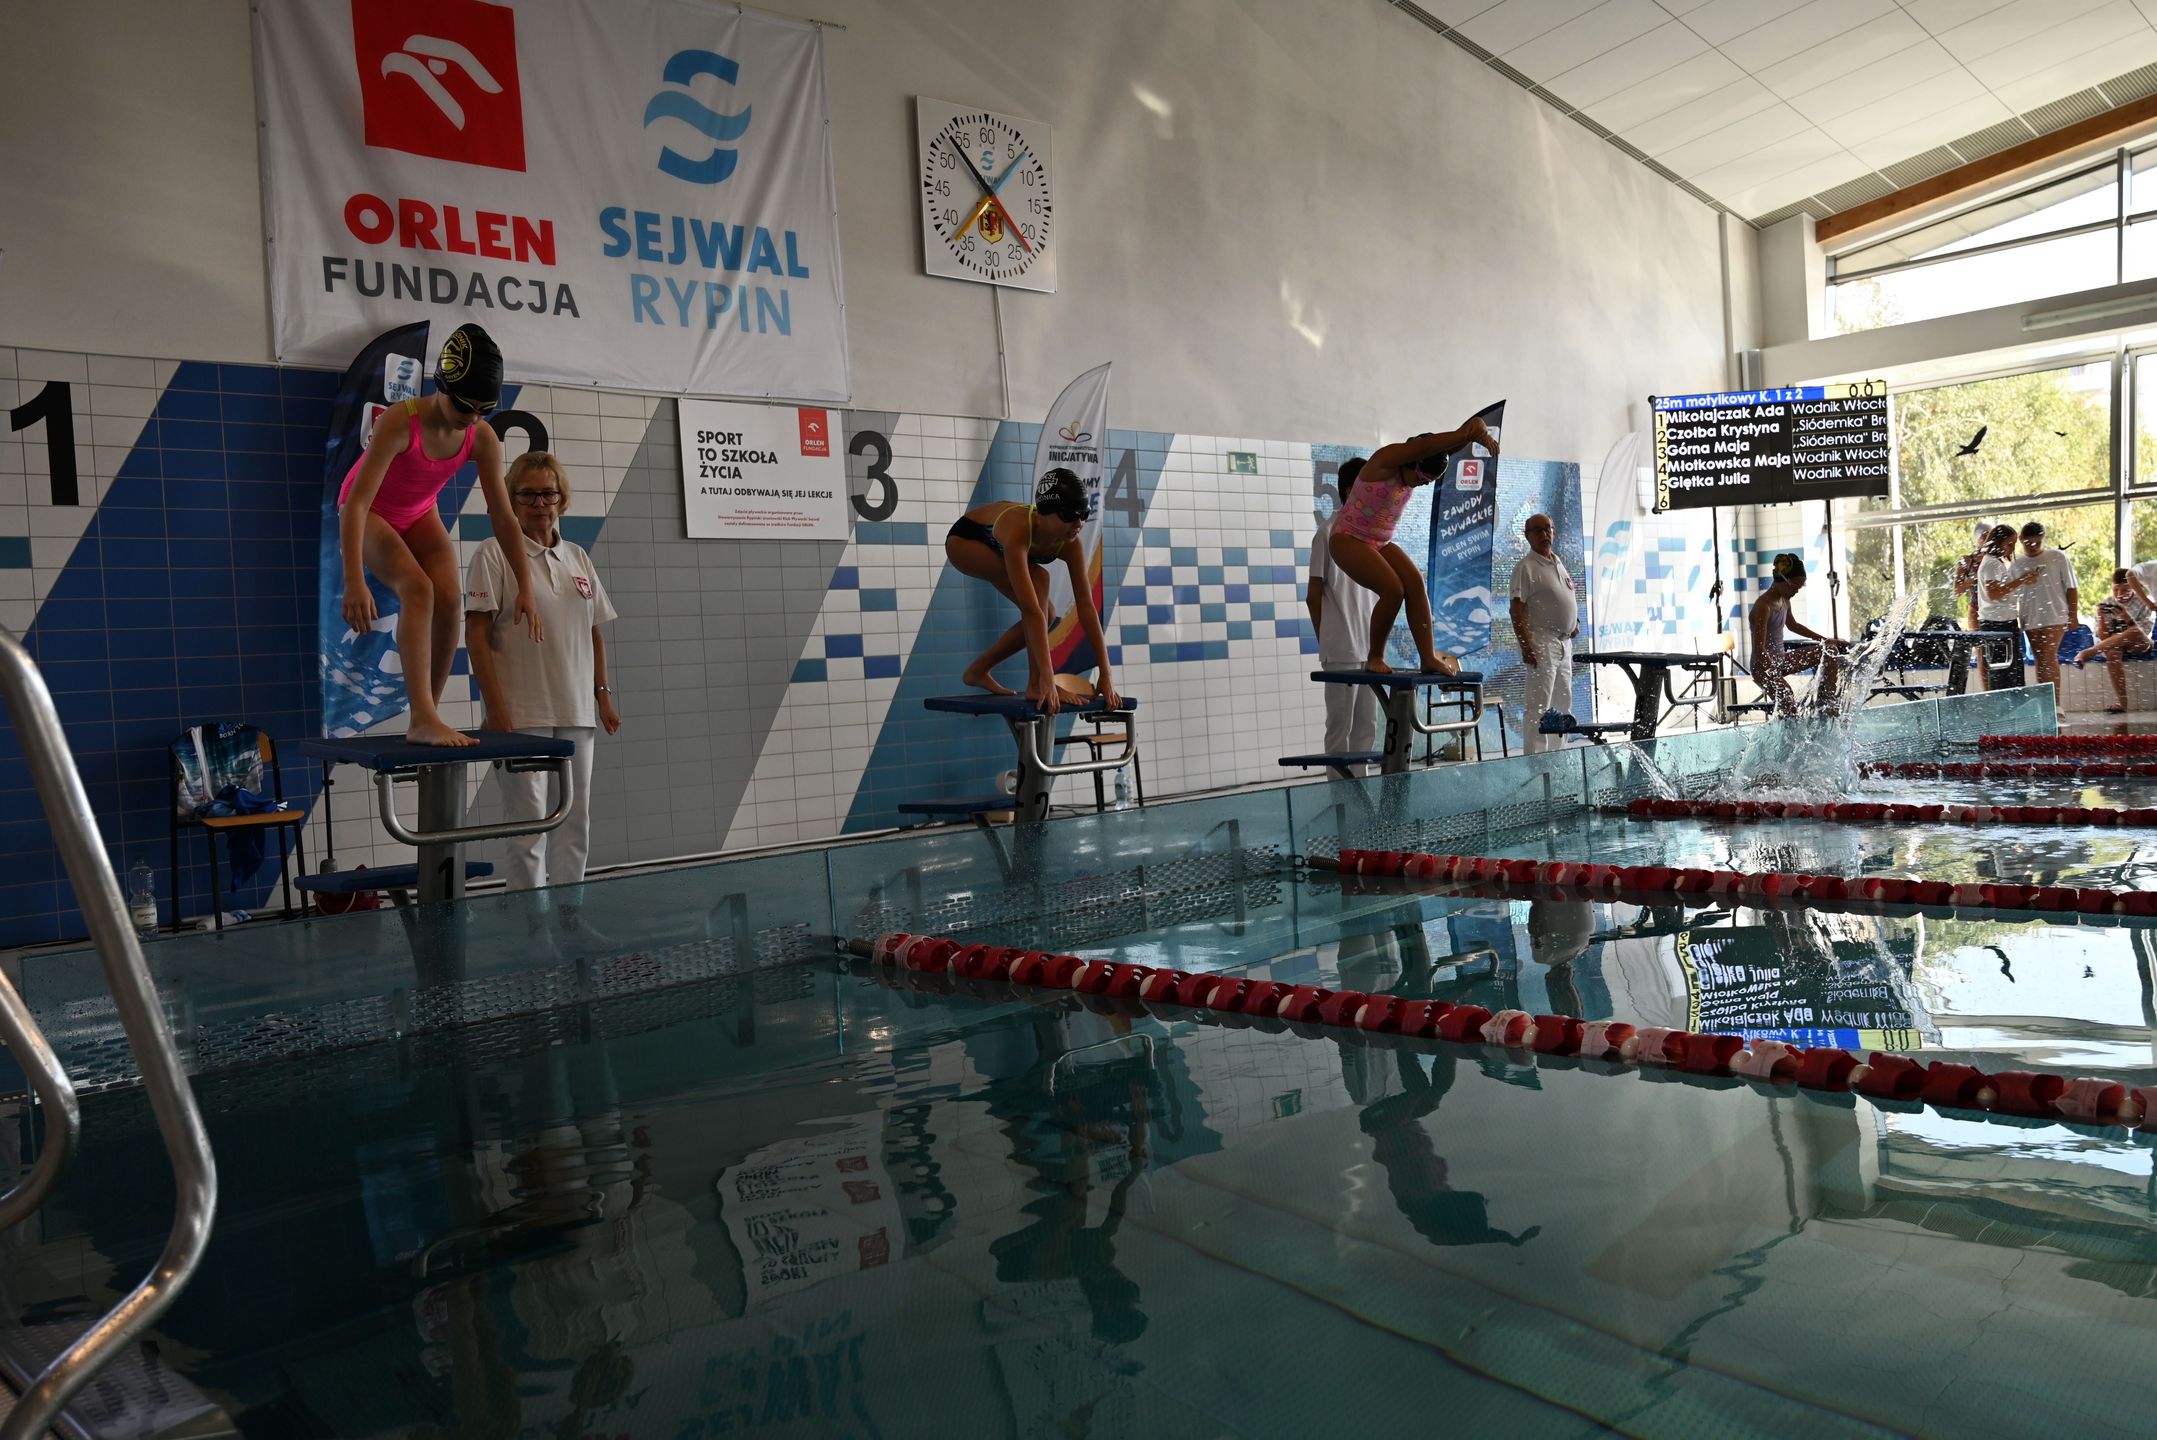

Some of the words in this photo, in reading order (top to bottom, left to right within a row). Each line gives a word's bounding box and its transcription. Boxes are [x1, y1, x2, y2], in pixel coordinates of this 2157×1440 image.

[955, 131, 970, 149] 55
[980, 128, 995, 145] 60
[1008, 144, 1015, 159] 5
[940, 153, 956, 170] 50
[1020, 170, 1034, 187] 10
[935, 180, 950, 197] 45
[1028, 199, 1042, 215] 15
[942, 209, 959, 226] 40
[344, 193, 556, 266] ORLEN
[1021, 223, 1036, 240] 20
[599, 207, 810, 279] SEJWAL
[960, 235, 975, 252] 35
[1007, 243, 1023, 261] 25
[984, 250, 1000, 268] 30
[322, 256, 580, 318] FUNDACJA
[630, 273, 792, 336] RYPIN
[388, 382, 417, 396] SEJWAL
[1655, 398, 1682, 409] 25m
[1686, 394, 1756, 407] motylkowy
[1760, 391, 1771, 402] K.
[1776, 390, 1781, 400] 1
[1786, 391, 1792, 400] z
[1795, 388, 1803, 399] 2
[1658, 414, 1664, 427] 1
[1666, 407, 1751, 423] Mikołajczak
[1754, 405, 1785, 418] Ada
[1791, 401, 1841, 415] Wodnik
[697, 431, 743, 446] SPORT
[1657, 431, 1666, 443] 2
[1666, 426, 1716, 440] Czołba
[1720, 422, 1780, 439] Krystyna
[10, 381, 79, 506] 1
[1658, 447, 1666, 459] 3
[1666, 442, 1710, 456] Górna
[1714, 440, 1750, 454] Maja
[698, 448, 717, 461] TO
[722, 450, 778, 464] SZKOŁA
[1658, 463, 1667, 475] 4
[1667, 456, 1751, 473] Młotkowska
[1754, 452, 1791, 468] Maja
[1793, 450, 1841, 464] Wodnik
[700, 461, 742, 479] ŻYCIA
[849, 430, 898, 521] 3
[1793, 467, 1842, 480] Wodnik
[1104, 449, 1145, 528] 4
[1659, 479, 1668, 492] 5
[1667, 475, 1714, 490] Giętka
[1718, 472, 1750, 486] Julia
[701, 487, 707, 495] A
[734, 488, 780, 499] ODBYWAJĄ
[782, 490, 793, 499] SIĘ
[795, 490, 805, 498] JEJ
[808, 491, 832, 499] LEKCJE
[1660, 496, 1668, 508] 6
[1443, 494, 1482, 520] ZAWODY
[1440, 505, 1493, 539] PŁYWACKIE
[1442, 540, 1467, 556] ORLEN
[1468, 530, 1489, 544] SWIM
[1457, 545, 1481, 560] RYPIN
